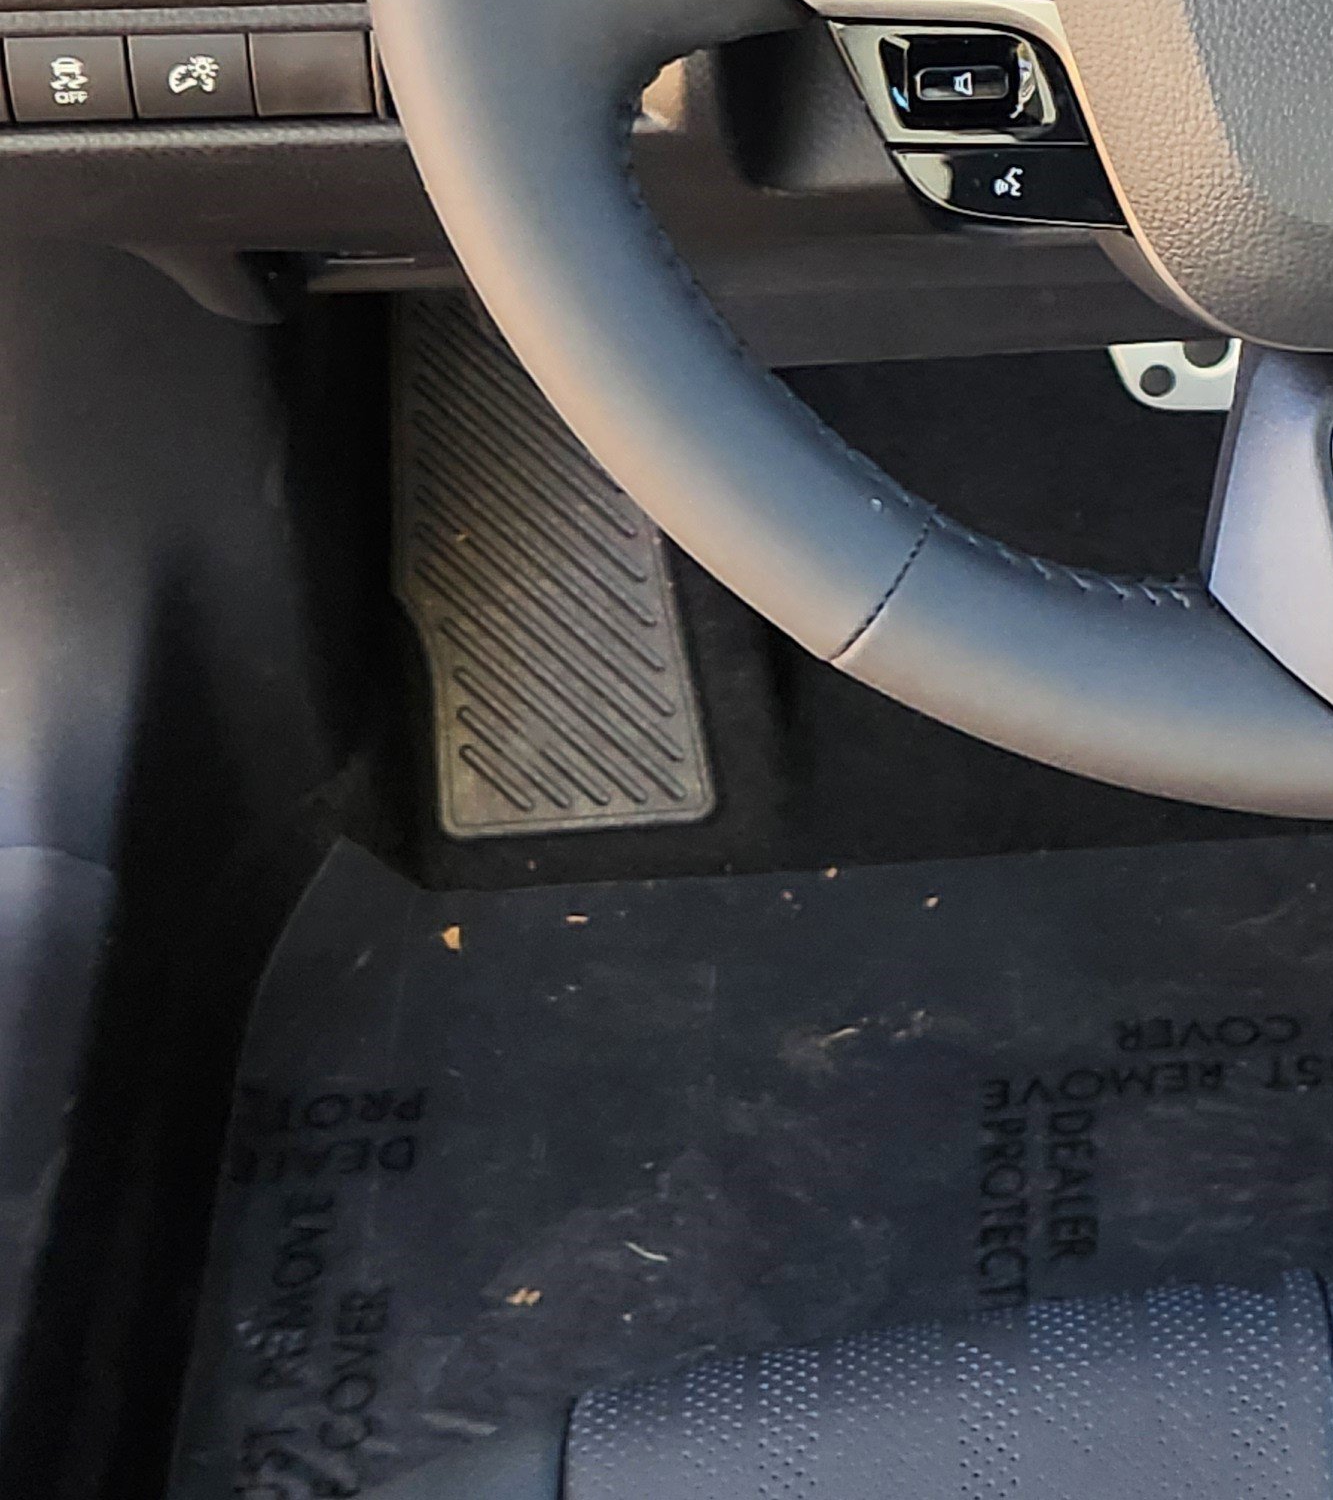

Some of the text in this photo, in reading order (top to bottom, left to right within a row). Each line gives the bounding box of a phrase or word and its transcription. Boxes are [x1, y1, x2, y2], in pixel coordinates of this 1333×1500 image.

[1112, 1015, 1302, 1054] COVER
[982, 1061, 1224, 1114] REMOVE
[1049, 1109, 1100, 1262] DEALER
